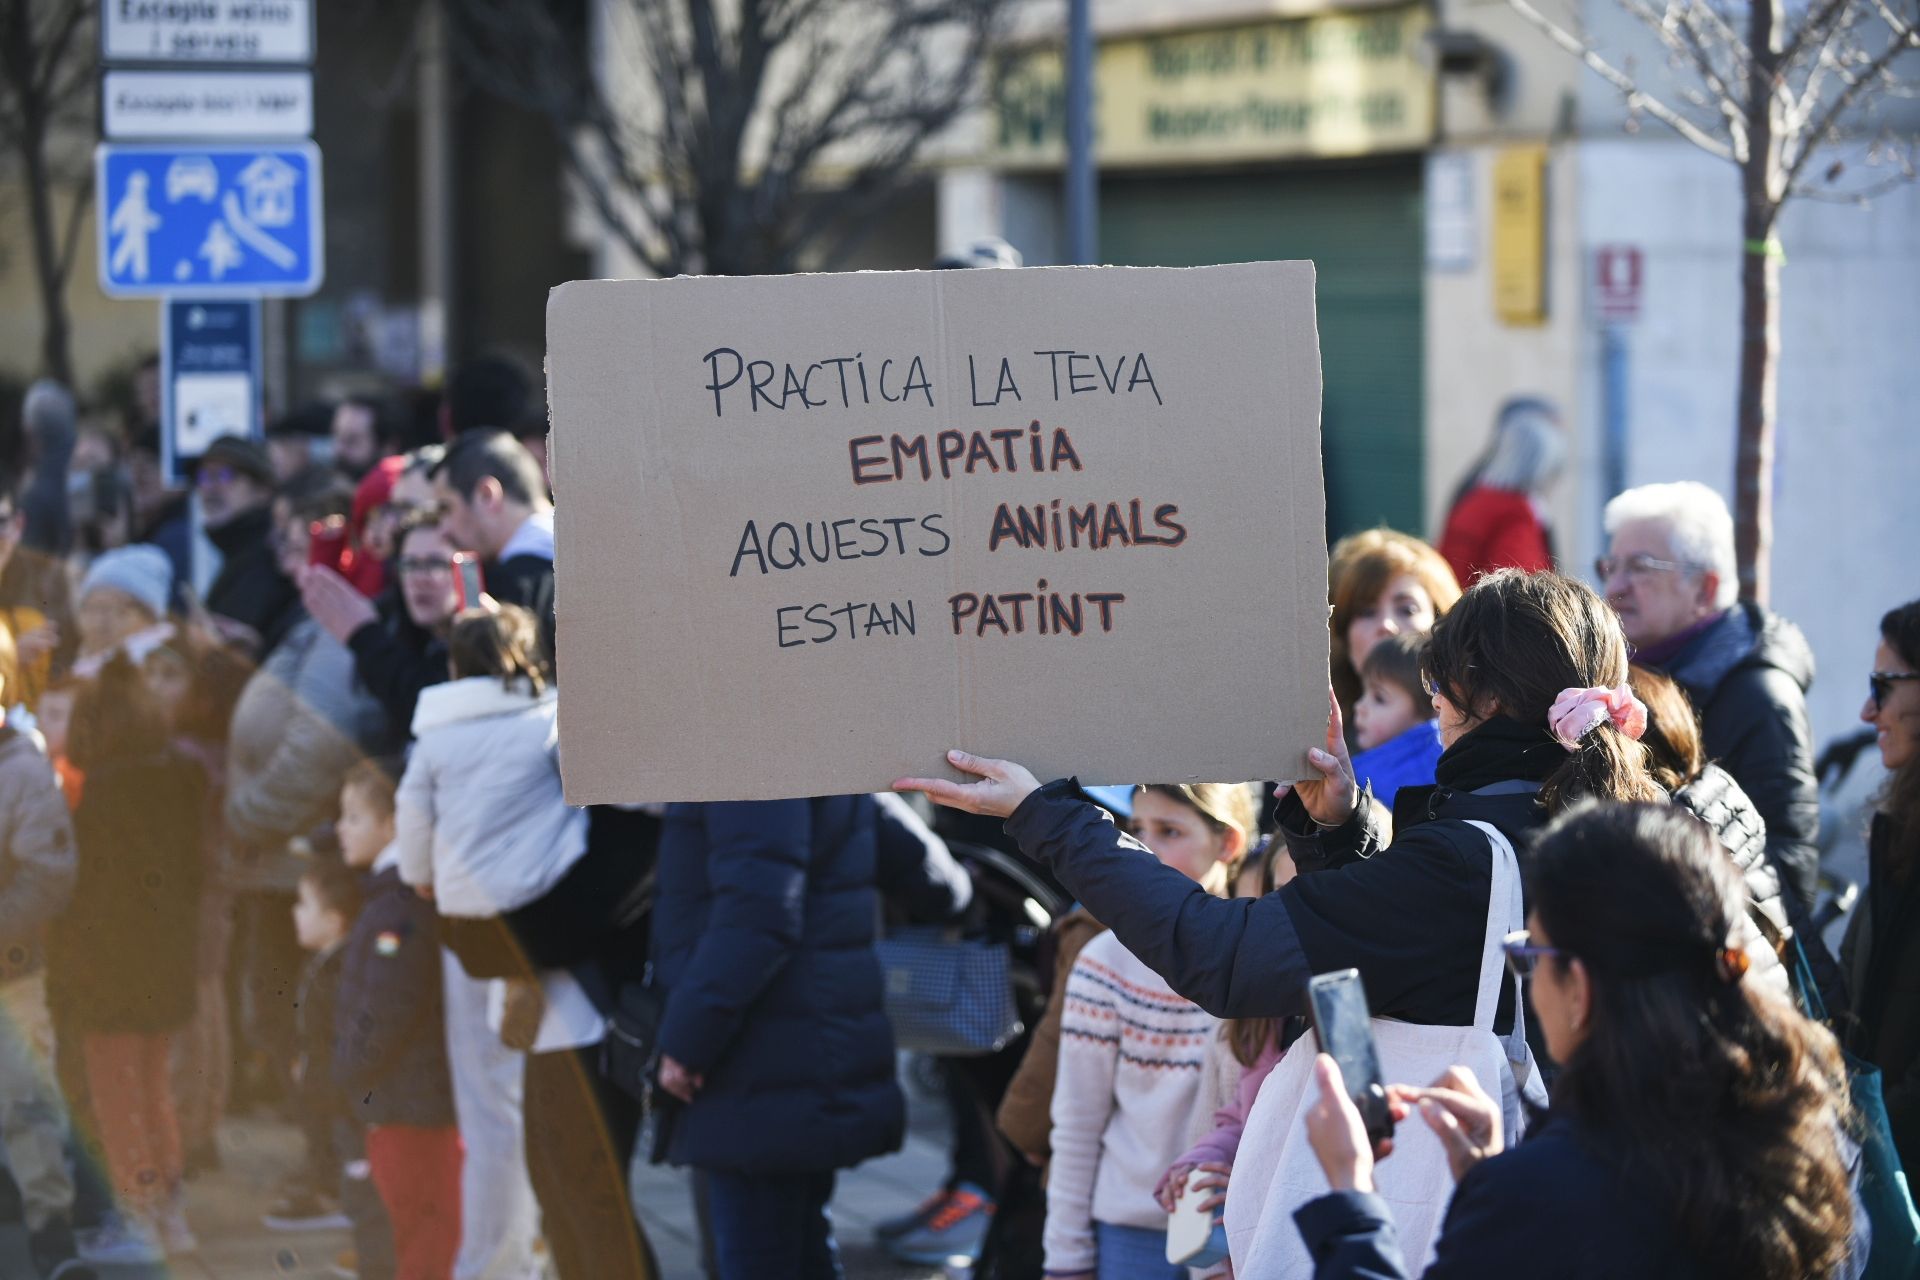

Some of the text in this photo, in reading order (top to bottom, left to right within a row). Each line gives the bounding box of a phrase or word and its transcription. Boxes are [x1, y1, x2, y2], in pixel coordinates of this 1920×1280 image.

[969, 355, 1021, 406] LA
[1034, 351, 1162, 405] TEVA
[730, 514, 950, 577] AQUESTS
[777, 600, 915, 647] ESTAN
